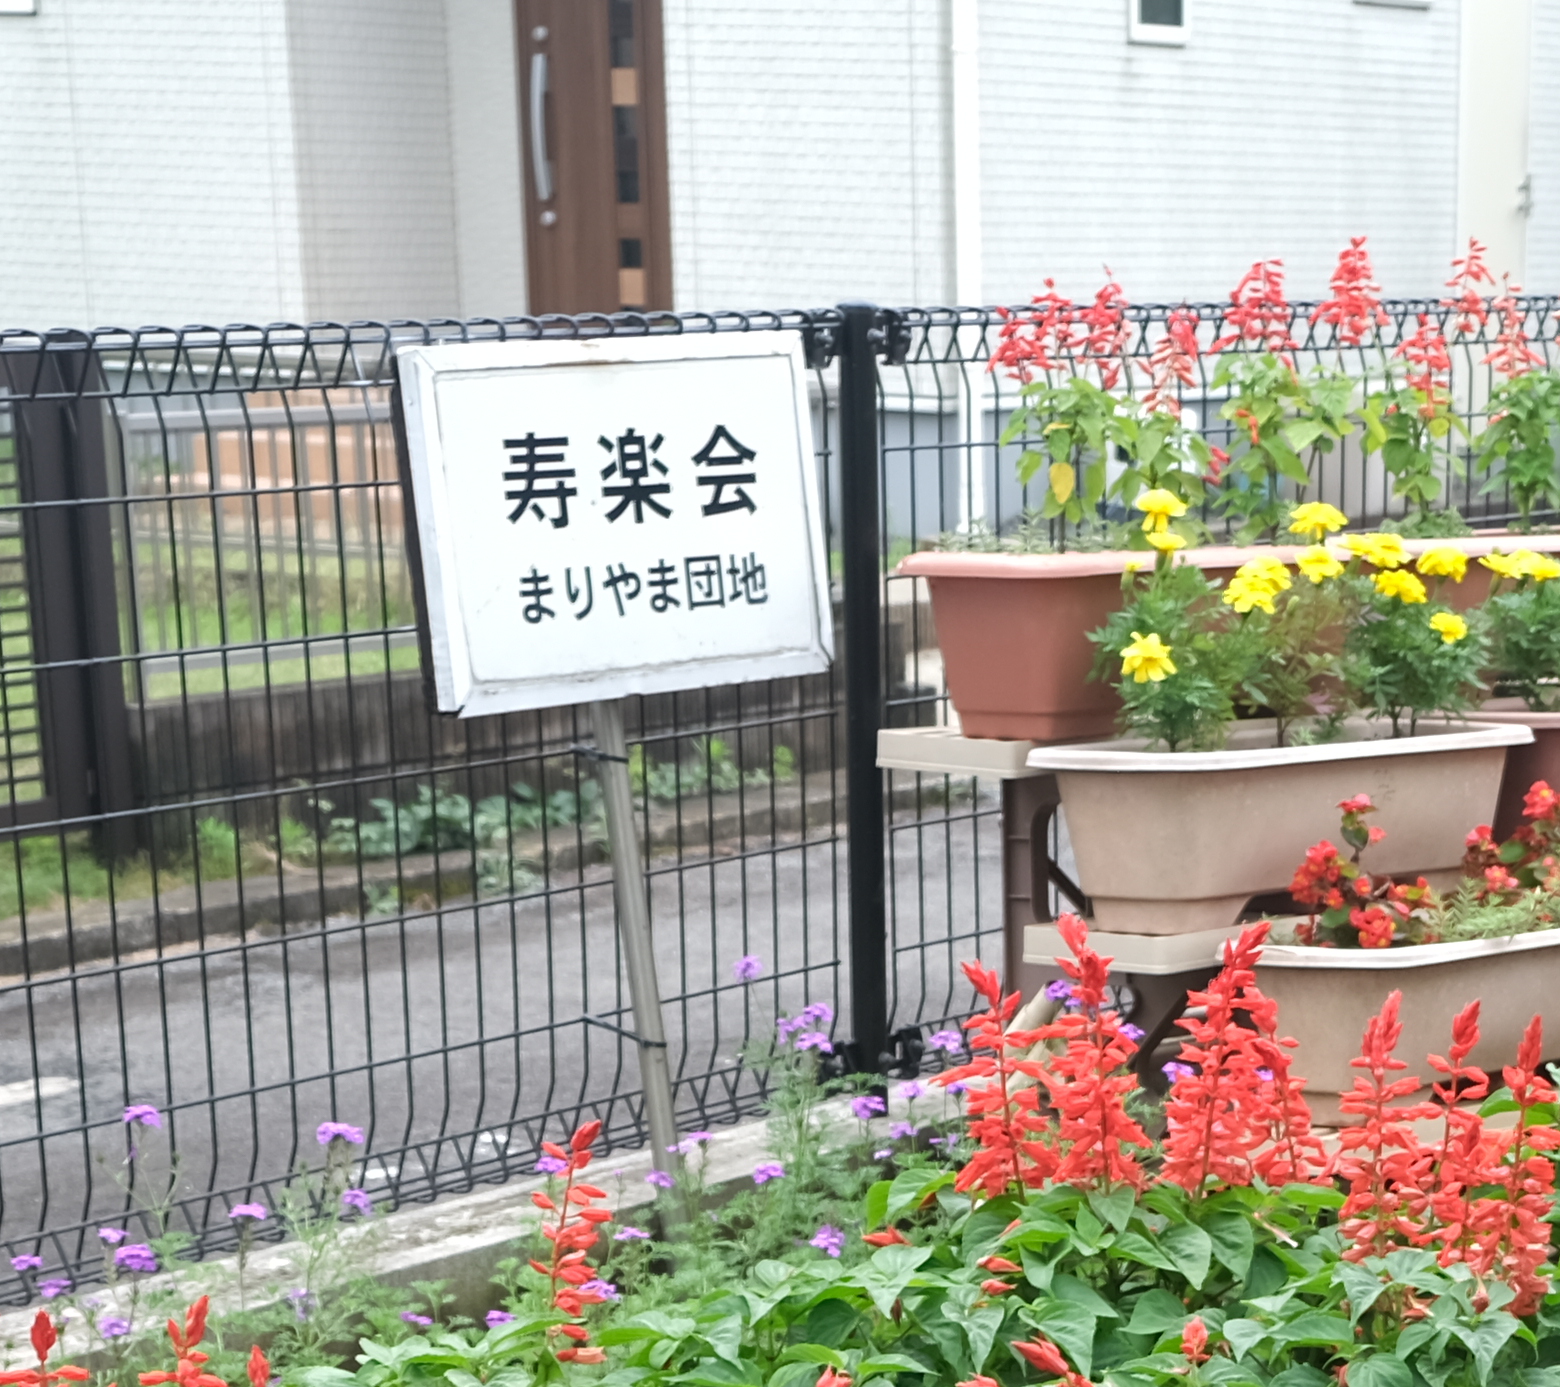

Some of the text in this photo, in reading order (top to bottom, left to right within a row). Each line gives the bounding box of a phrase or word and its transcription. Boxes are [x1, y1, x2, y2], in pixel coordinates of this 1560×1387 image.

[501, 424, 758, 529] 寿楽会
[519, 552, 769, 625] まりやま団地
